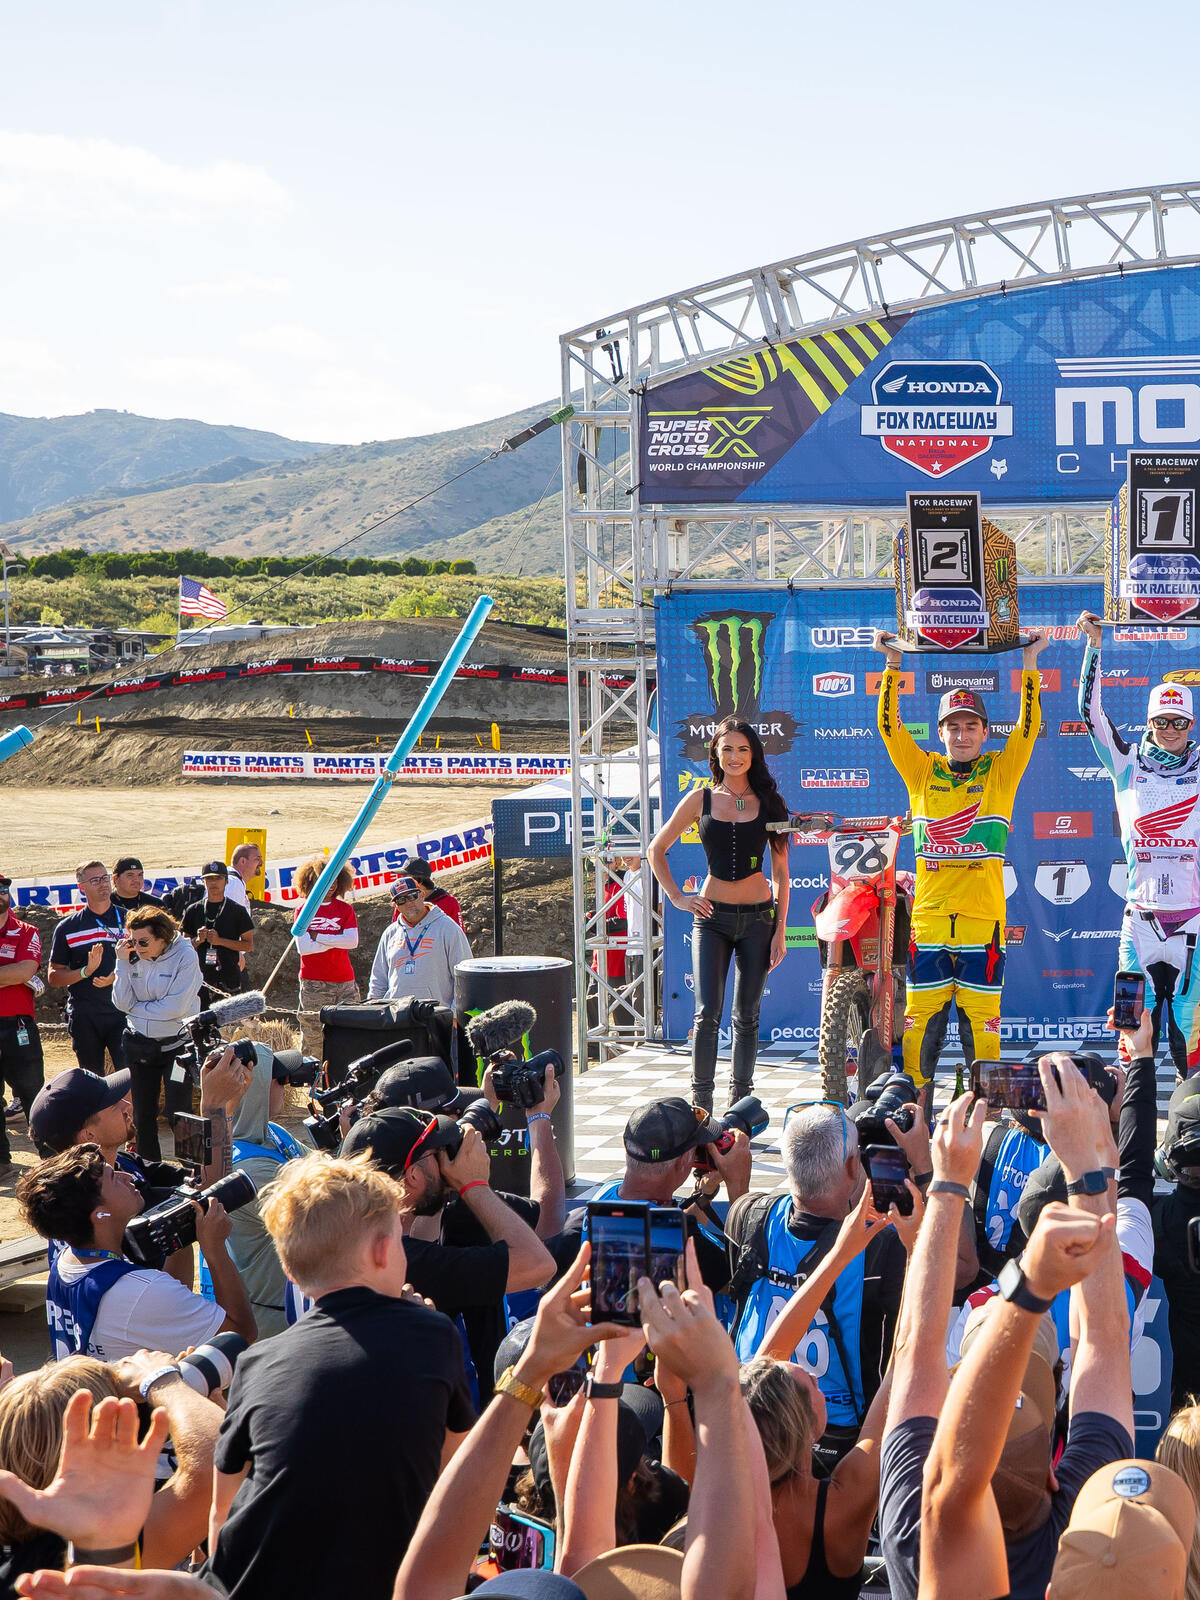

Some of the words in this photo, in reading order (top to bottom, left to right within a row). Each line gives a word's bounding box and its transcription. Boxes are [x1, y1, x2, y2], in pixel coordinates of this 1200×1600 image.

[907, 382, 992, 393] HONDA
[648, 420, 712, 432] SUPER
[877, 412, 909, 429] FOX
[913, 411, 997, 430] RACEWAY
[652, 432, 708, 444] MOTO
[896, 439, 979, 447] NATIONAL
[648, 444, 709, 456] CROSS
[649, 463, 684, 472] WORLD
[686, 461, 766, 471] CHAMPIONSHIP
[1152, 496, 1181, 540] 1
[930, 541, 960, 570] 2
[1126, 584, 1148, 594] FOX
[912, 615, 931, 624] FOX
[934, 615, 985, 625] RACEWAY
[812, 627, 876, 648] WPS
[1115, 632, 1187, 641] UNLIMITED
[818, 677, 849, 692] 100%
[944, 677, 994, 687] Husqvarna
[815, 727, 874, 738] NAMURA
[183, 755, 241, 766] PARTS
[245, 756, 304, 767] PARTS
[313, 757, 375, 768] PARTS
[447, 757, 512, 768] PARTS
[516, 758, 571, 768] PART
[182, 765, 242, 773] UNLIMITED
[245, 766, 304, 774] UNLIMITED
[313, 767, 375, 775] UNLIMITED
[447, 767, 512, 775] UNLIMITED
[801, 769, 869, 780] PARTS
[802, 780, 869, 788] UNLIMITED
[922, 843, 987, 855] HONDA
[1135, 839, 1198, 848] HONDA
[835, 843, 888, 876] 96
[1042, 969, 1094, 977] HONDA
[883, 992, 891, 1046] DUNLOP
[1000, 1024, 1116, 1039] OTOCROSS
